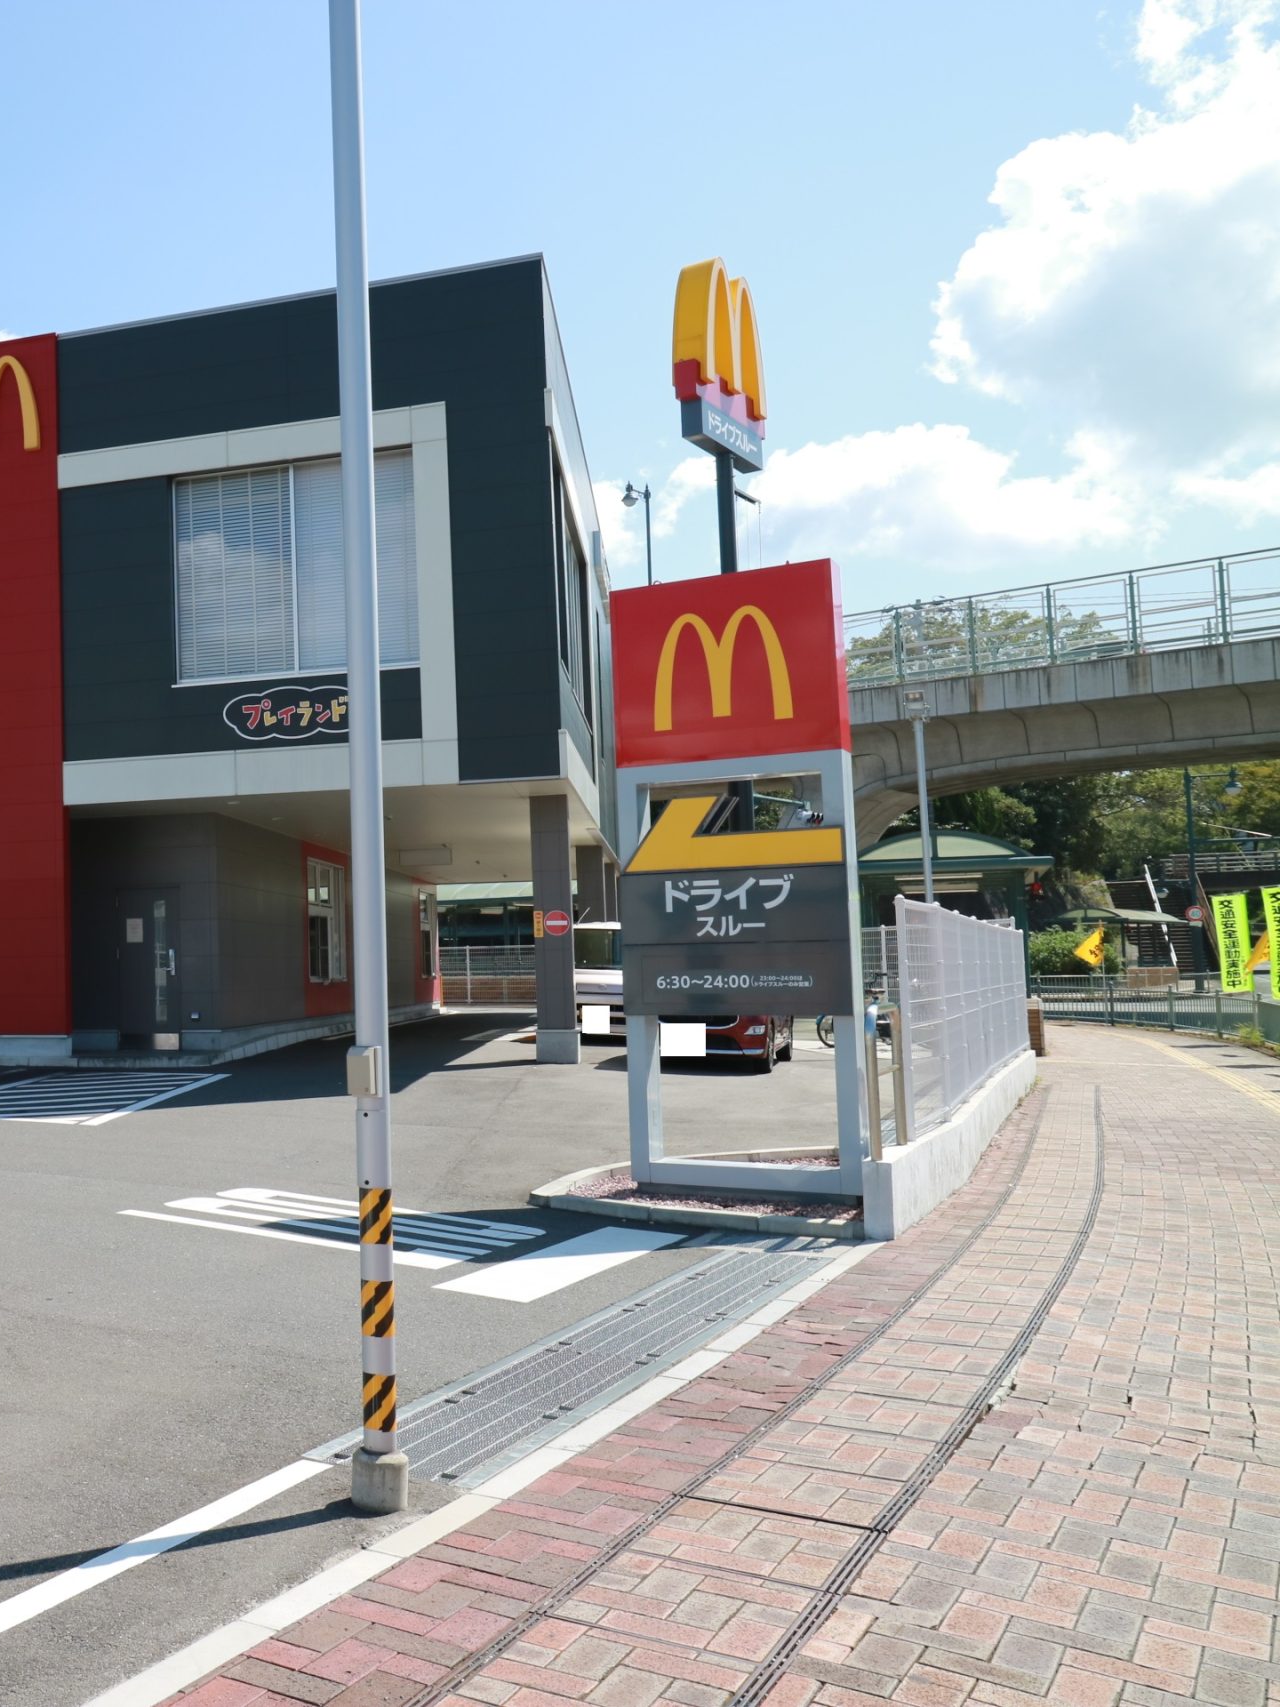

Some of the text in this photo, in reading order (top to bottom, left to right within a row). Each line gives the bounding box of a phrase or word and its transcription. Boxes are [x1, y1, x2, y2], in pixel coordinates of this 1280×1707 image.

[707, 410, 757, 453] ドライブスルー
[242, 695, 349, 730] プレイランド
[664, 873, 795, 913] ドライブ
[696, 915, 766, 937] スルー
[1218, 899, 1242, 989] 交通安全運動実施中
